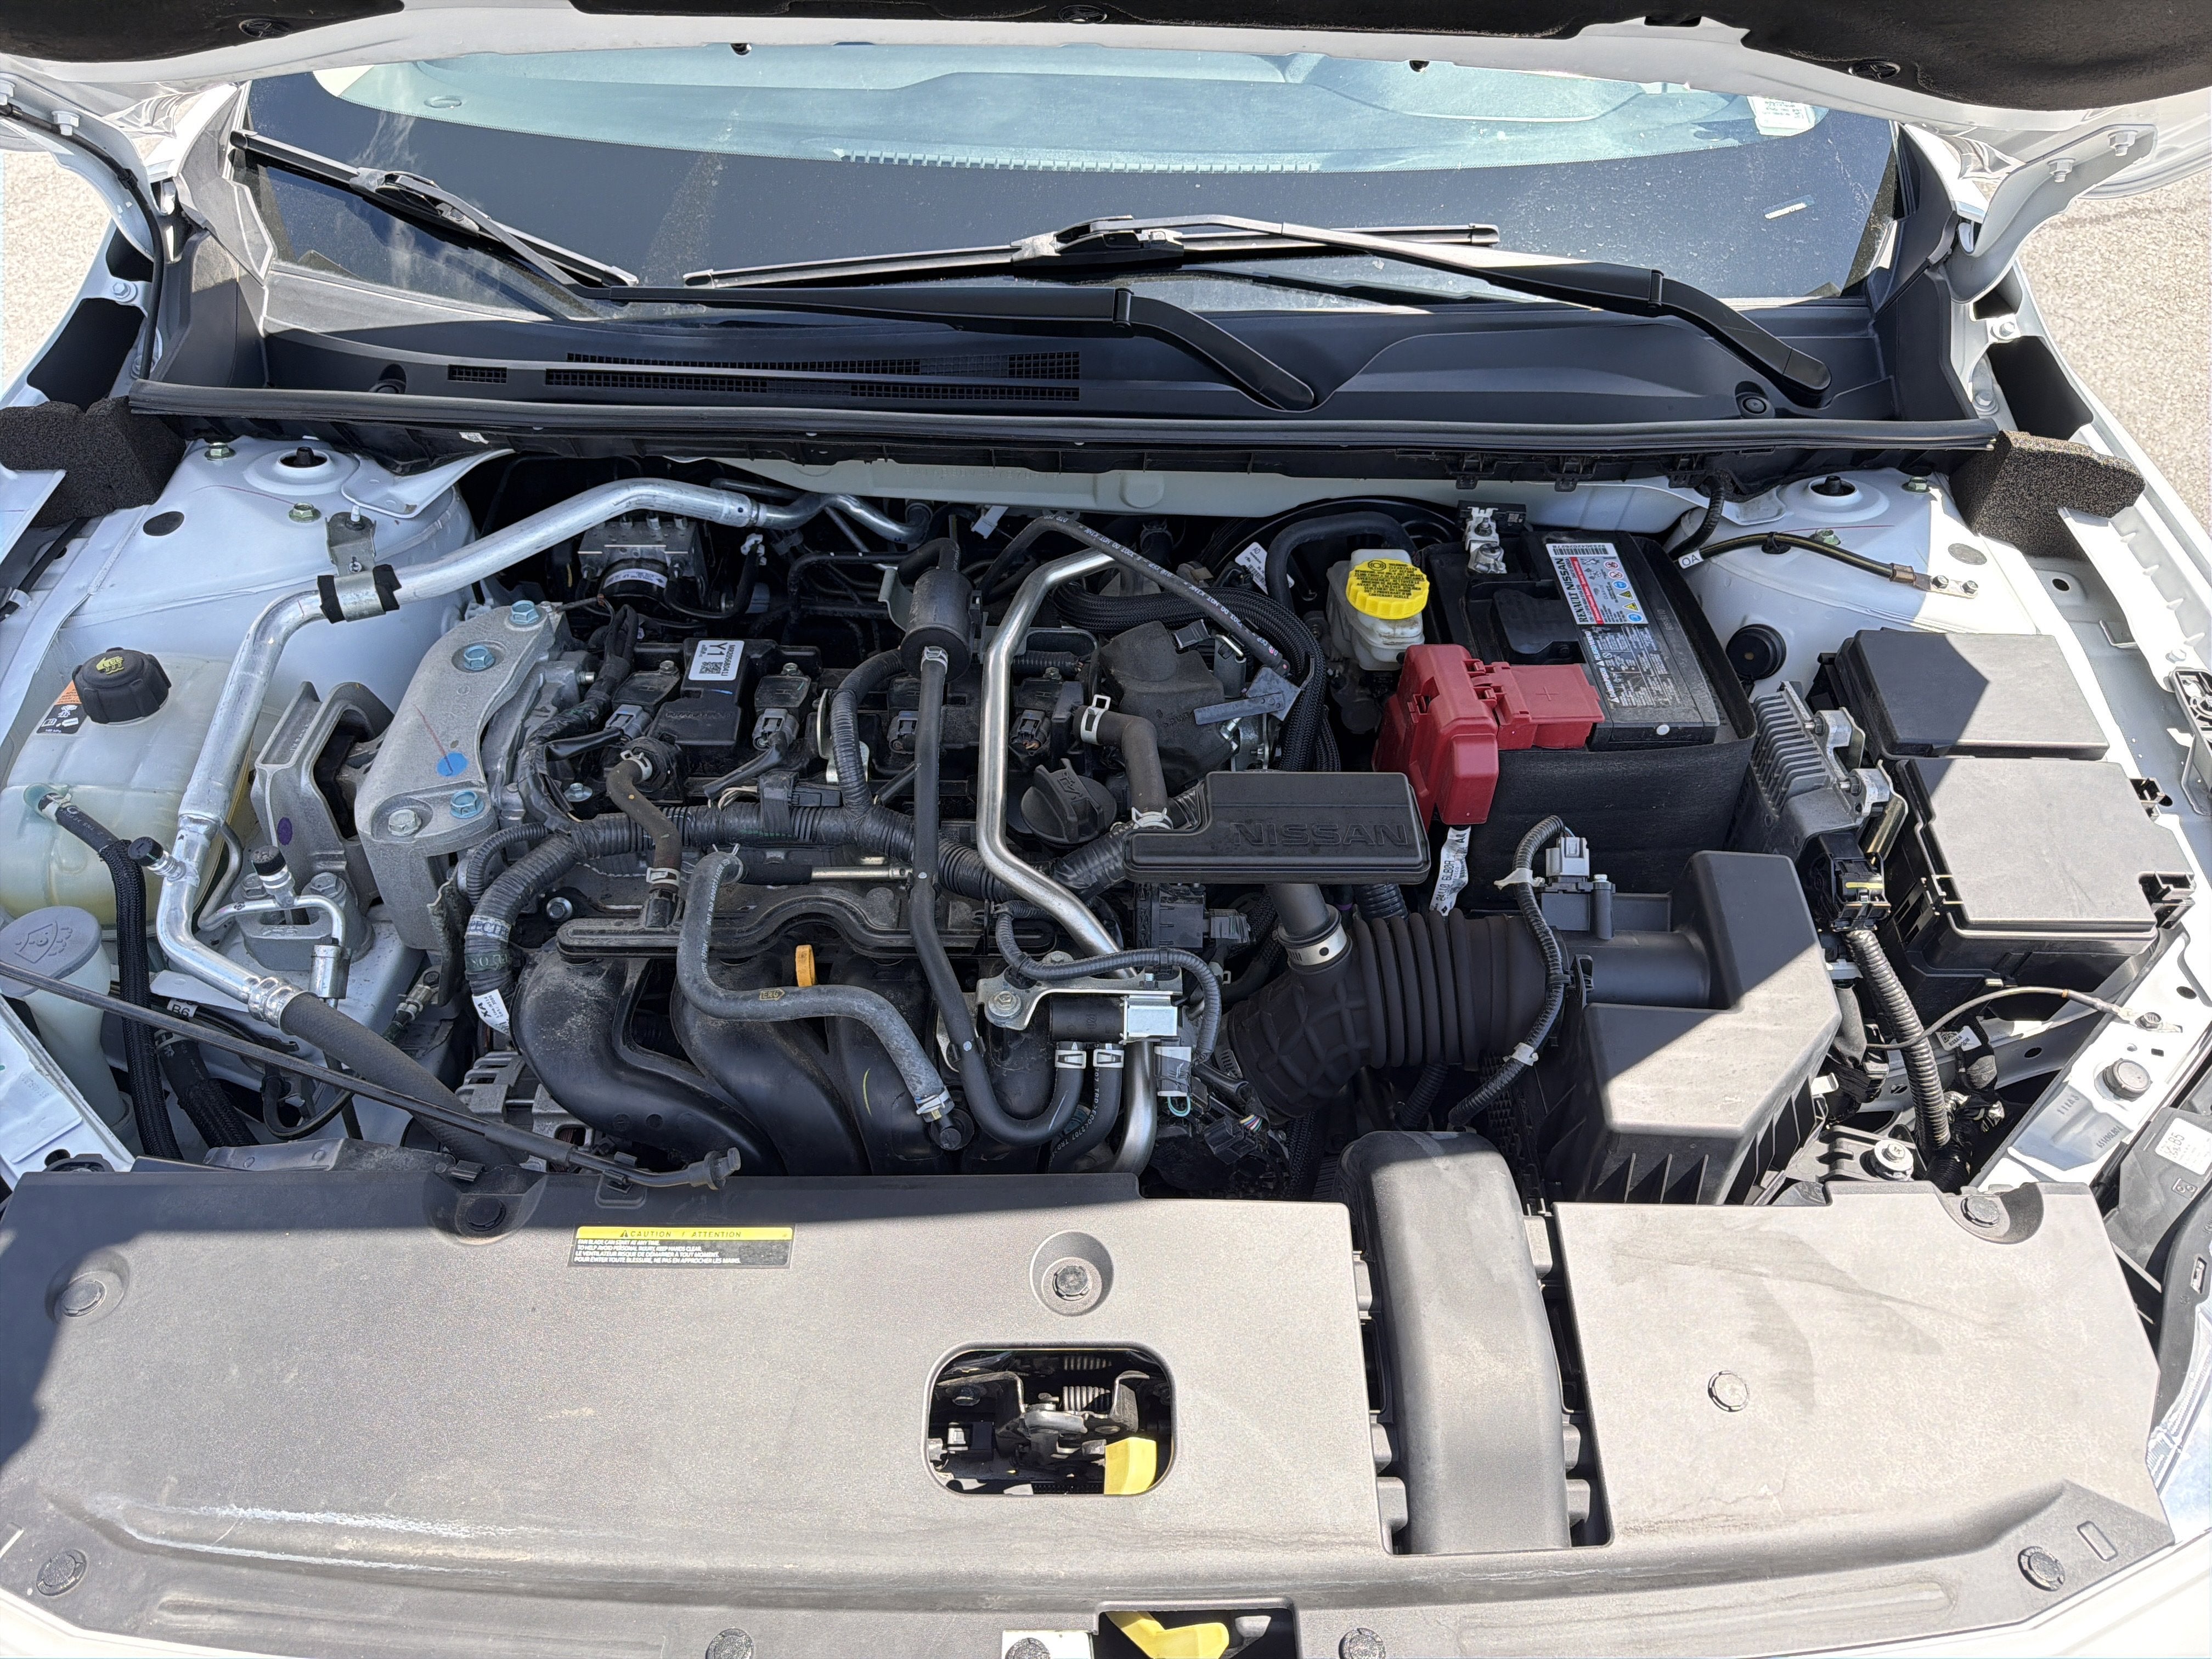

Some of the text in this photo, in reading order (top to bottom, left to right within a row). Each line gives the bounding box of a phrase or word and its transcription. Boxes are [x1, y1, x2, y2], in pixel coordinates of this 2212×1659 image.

[1681, 554, 1700, 566] OA
[1555, 558, 1576, 590] NISSAN
[1568, 592, 1588, 623] RENAULT
[707, 642, 729, 656] Y1
[1229, 821, 1408, 847] NISSAN
[172, 1003, 190, 1017] B6
[478, 1002, 492, 1018] XA
